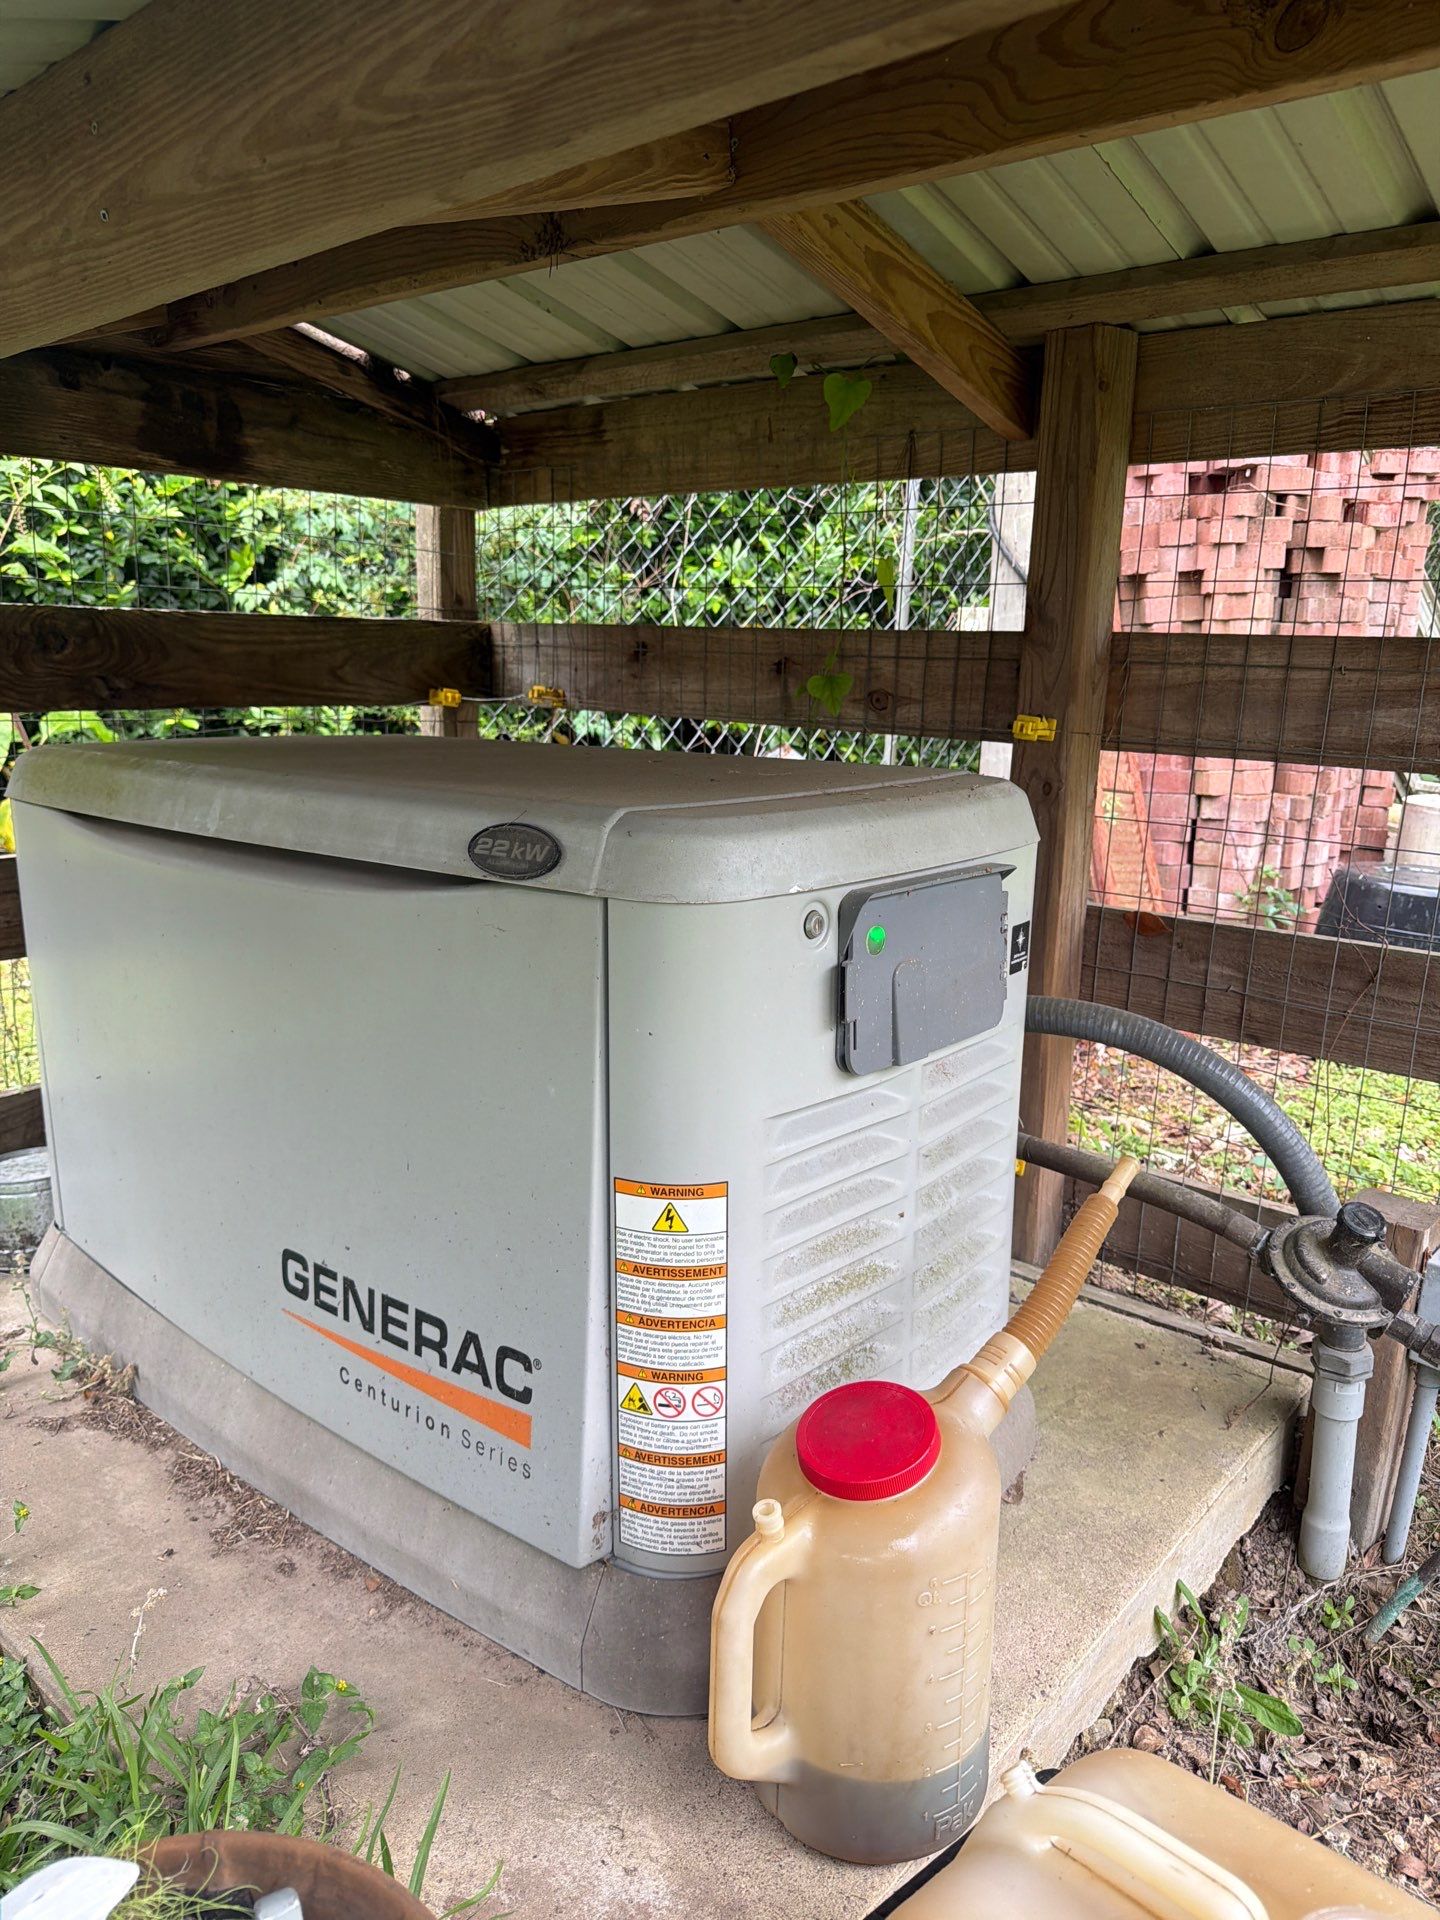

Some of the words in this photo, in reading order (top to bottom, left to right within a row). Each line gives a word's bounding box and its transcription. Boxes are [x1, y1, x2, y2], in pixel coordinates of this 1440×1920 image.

[650, 1186, 704, 1197] WARNING
[632, 1265, 723, 1278] AVERTISSEMENT
[638, 1317, 716, 1329] ADVERTENCIA
[651, 1371, 704, 1381] WARNING
[339, 1366, 451, 1439] Centurion
[461, 1429, 531, 1480] Series
[634, 1451, 723, 1466] AVERTISSEMENT
[639, 1503, 716, 1517] ADVERTENCIA
